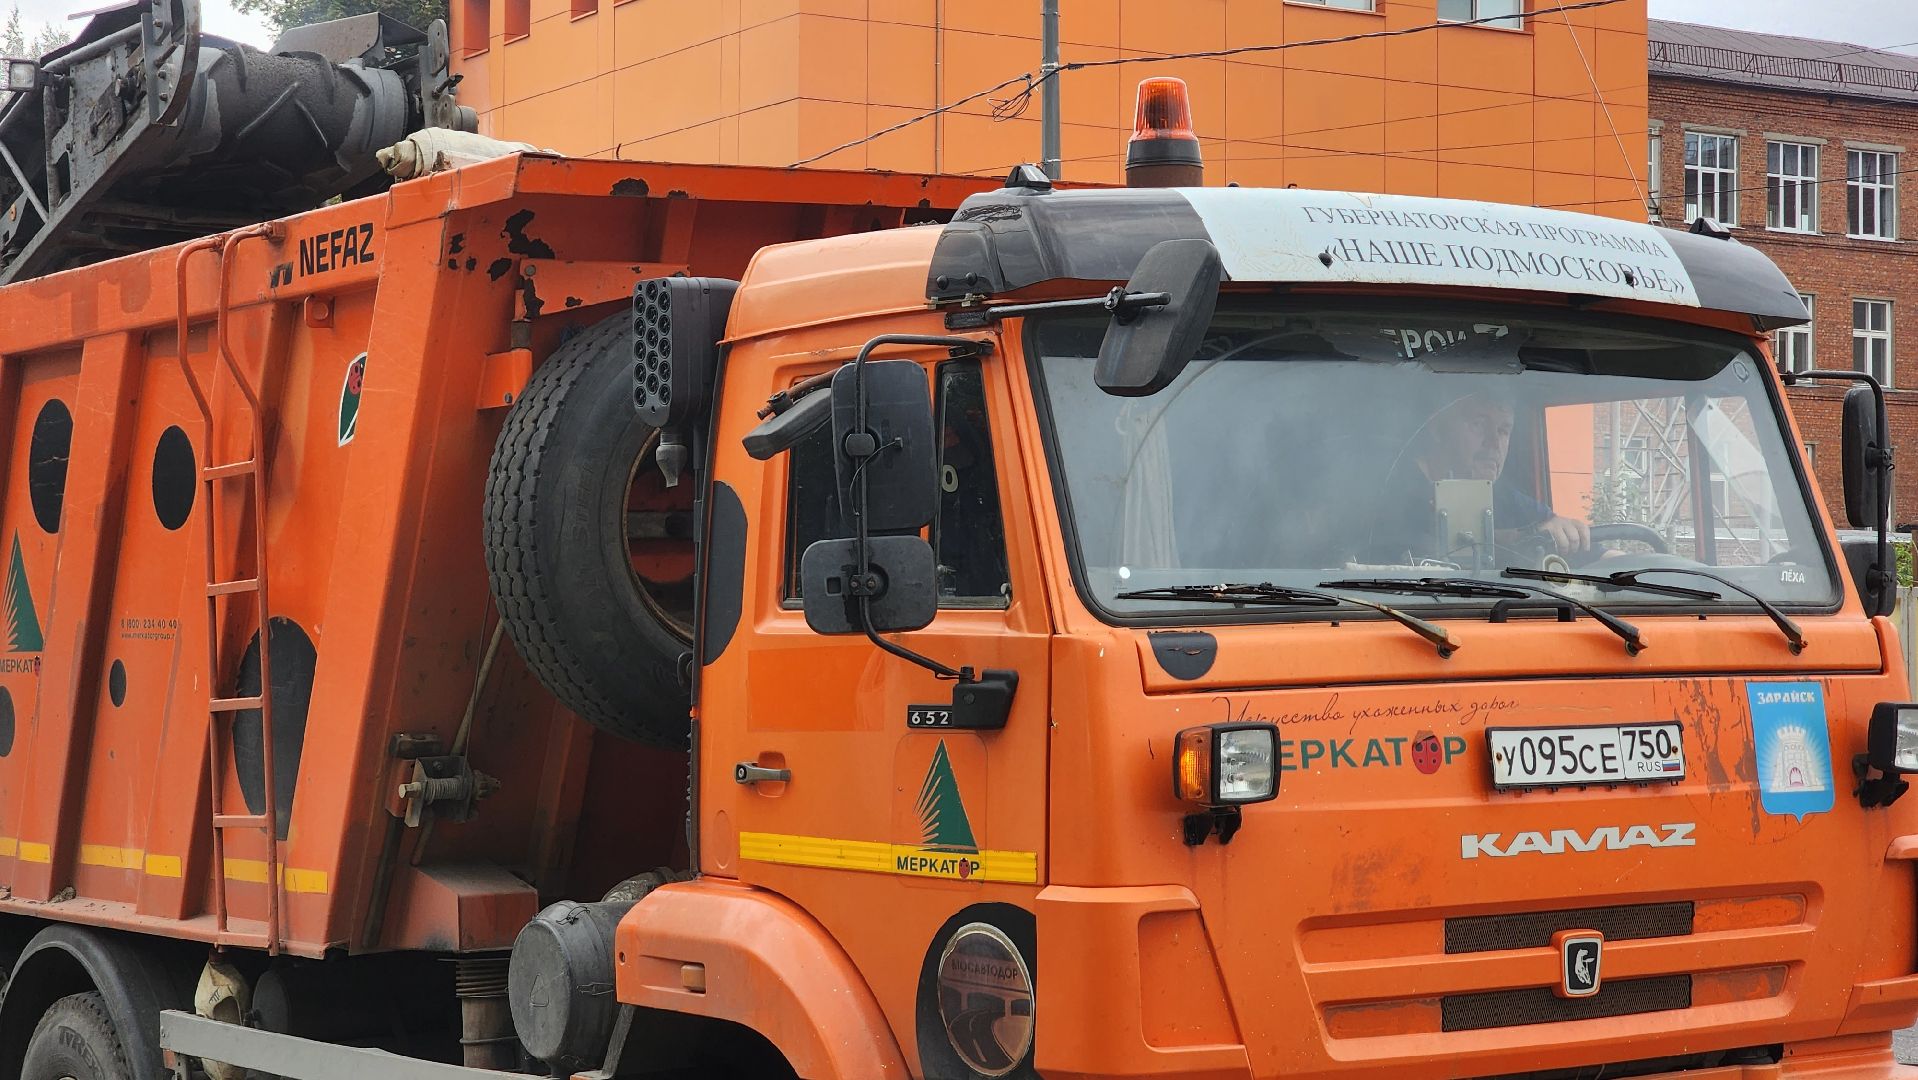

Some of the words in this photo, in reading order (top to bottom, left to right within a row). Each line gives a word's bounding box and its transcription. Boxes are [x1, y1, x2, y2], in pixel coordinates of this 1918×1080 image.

[1301, 206, 1527, 238] ГУБЕРНАТОРСКАЯ
[1527, 222, 1669, 258] ПРОГРАММА
[300, 222, 375, 278] NEFAZ
[1325, 237, 1443, 267] «НАШЕ
[1444, 244, 1685, 294] ПОДМОСКОВЬЕ»
[1781, 568, 1805, 584] ЛЁХА
[1757, 690, 1815, 705] ЗАРАЙСК
[911, 711, 949, 725] 652
[1281, 732, 1467, 775] ЕРКАТОР
[1622, 728, 1672, 761] 750
[1637, 761, 1662, 773] RUS
[1461, 823, 1696, 859] KAMAZ
